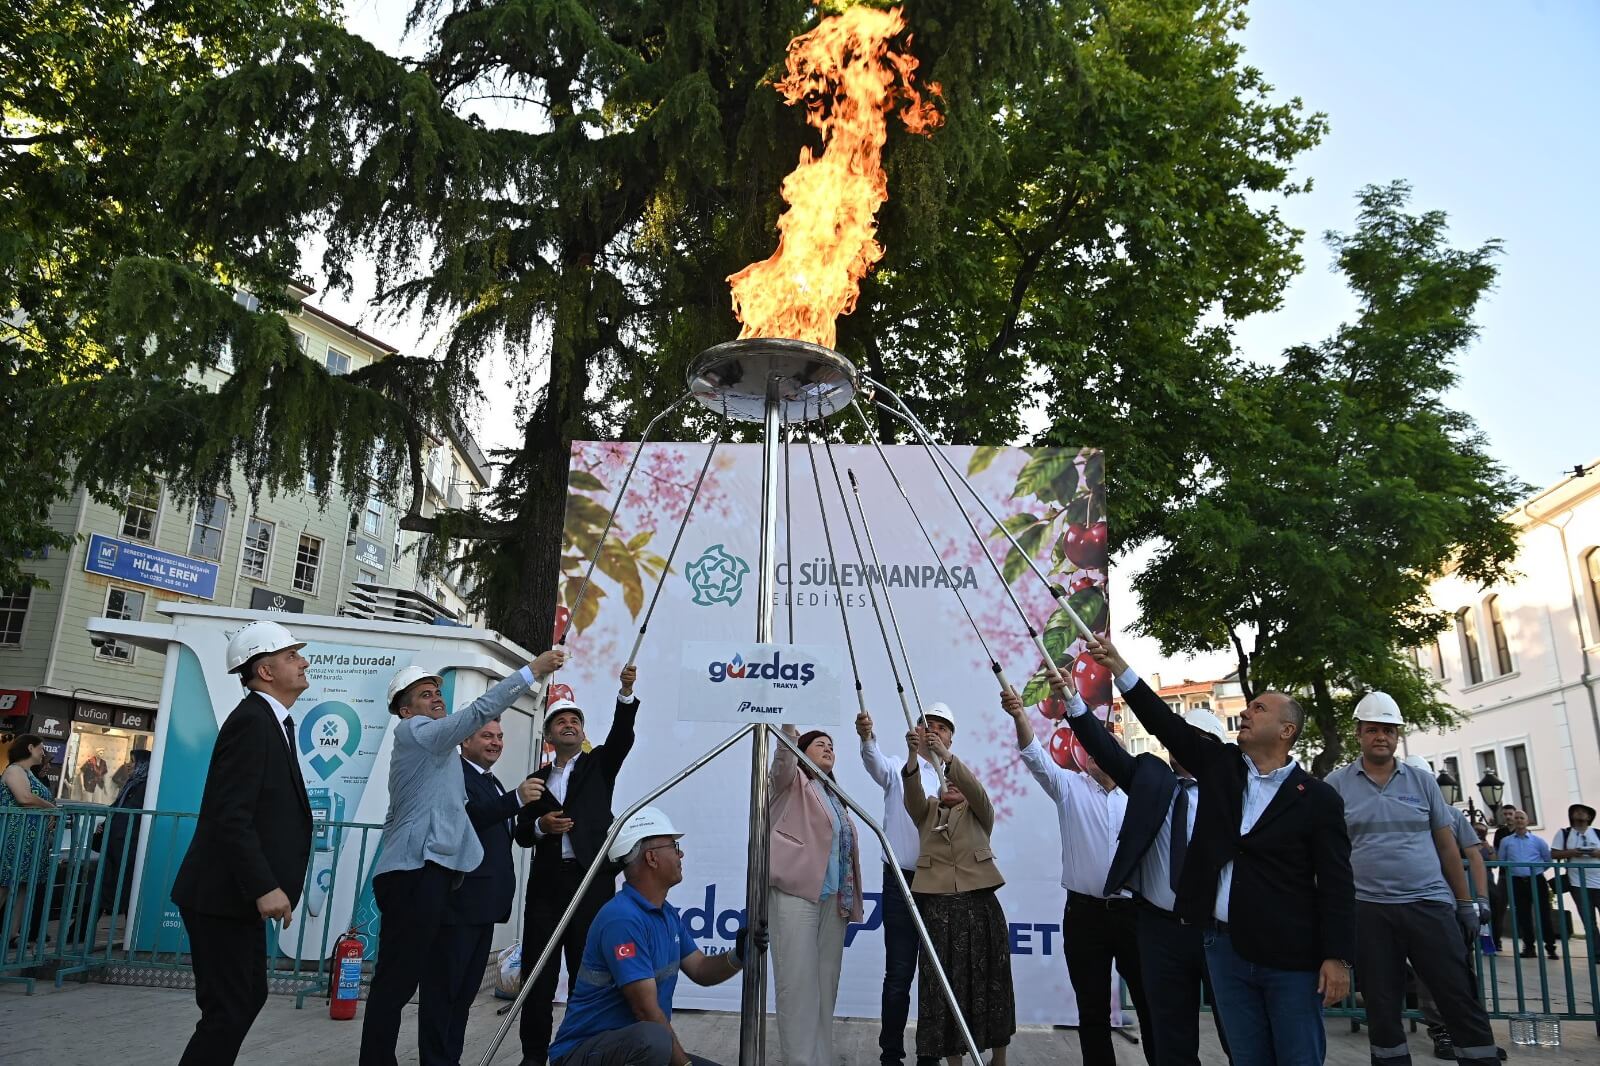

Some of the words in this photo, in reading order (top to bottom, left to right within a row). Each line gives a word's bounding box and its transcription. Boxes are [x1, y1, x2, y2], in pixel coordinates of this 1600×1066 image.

[133, 558, 166, 575] HİLAL
[169, 568, 198, 583] EREN
[798, 557, 979, 592] SÜLEYMANPAŞA
[773, 590, 877, 608] ELEDİYES
[353, 655, 396, 666] burada!
[709, 651, 815, 686] gazdaş
[78, 706, 108, 720] Lufian
[121, 712, 142, 727] Lee
[751, 706, 784, 714] PALMET
[319, 738, 339, 746] TAM
